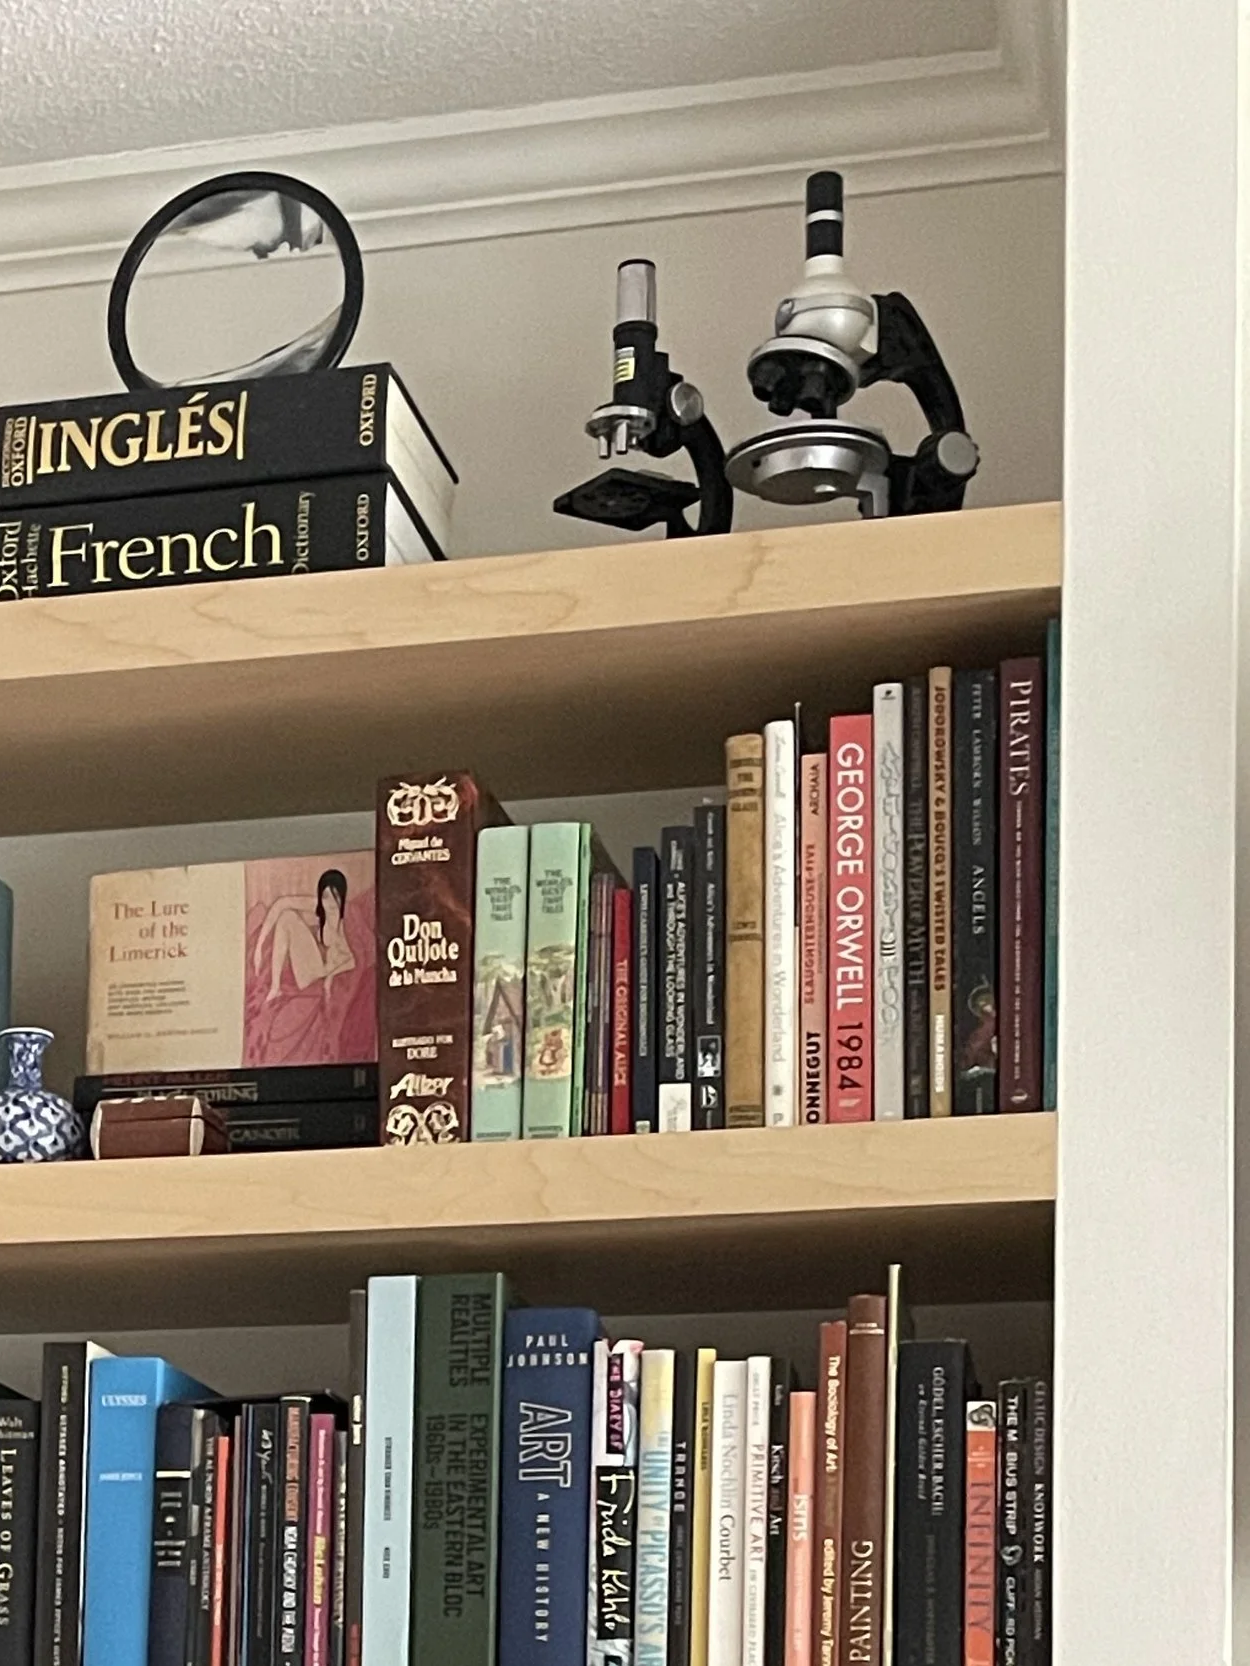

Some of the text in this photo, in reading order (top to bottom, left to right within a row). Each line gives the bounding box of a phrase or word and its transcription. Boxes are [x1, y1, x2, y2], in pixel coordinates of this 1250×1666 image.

[37, 391, 236, 474] INGLÉS
[359, 373, 378, 447] OXFORD
[10, 416, 28, 488] OXFORD
[47, 503, 283, 589] French
[356, 494, 370, 561] OXFORD
[1009, 680, 1032, 795] PIRATES
[113, 900, 189, 920] The Lure
[138, 921, 188, 940] of the
[403, 914, 443, 940] Don
[836, 742, 864, 1090] GEORGE ORWELL 1984
[972, 865, 986, 934] ANGELS
[109, 943, 188, 963] Limerick
[387, 937, 459, 968] Quijote
[771, 813, 788, 1062] Alice's Adventures in Wonderland
[935, 1015, 945, 1092] HUMANOIDS
[449, 1294, 469, 1387] REALITIES
[470, 1294, 491, 1386] MULTIPLE
[506, 1352, 588, 1368] JOHNSON
[526, 1334, 568, 1348] PAUL
[609, 1357, 622, 1450] THE DIARY OF
[519, 1402, 572, 1488] ART
[640, 1452, 667, 1511] UNITY
[770, 1445, 783, 1483] Kitsch
[0, 1449, 17, 1519] LEAVES
[443, 1413, 466, 1617] IN THE EASTERN BLOC
[466, 1414, 487, 1597] EXPERIMENTAL ART
[719, 1393, 736, 1581] Linda Nochlin Courbet
[750, 1444, 764, 1562] PRIMITIVE ART
[536, 1513, 549, 1549] NEW
[597, 1470, 634, 1630] Frida Kahlo
[770, 1514, 782, 1535] Art
[822, 1539, 833, 1576] edited
[967, 1481, 993, 1635] INFINITY
[535, 1563, 548, 1642] HISTORY
[638, 1530, 666, 1634] PICASSO'S
[821, 1595, 833, 1636] Jeremy
[822, 1577, 833, 1593] by
[848, 1540, 872, 1662] PAINTING
